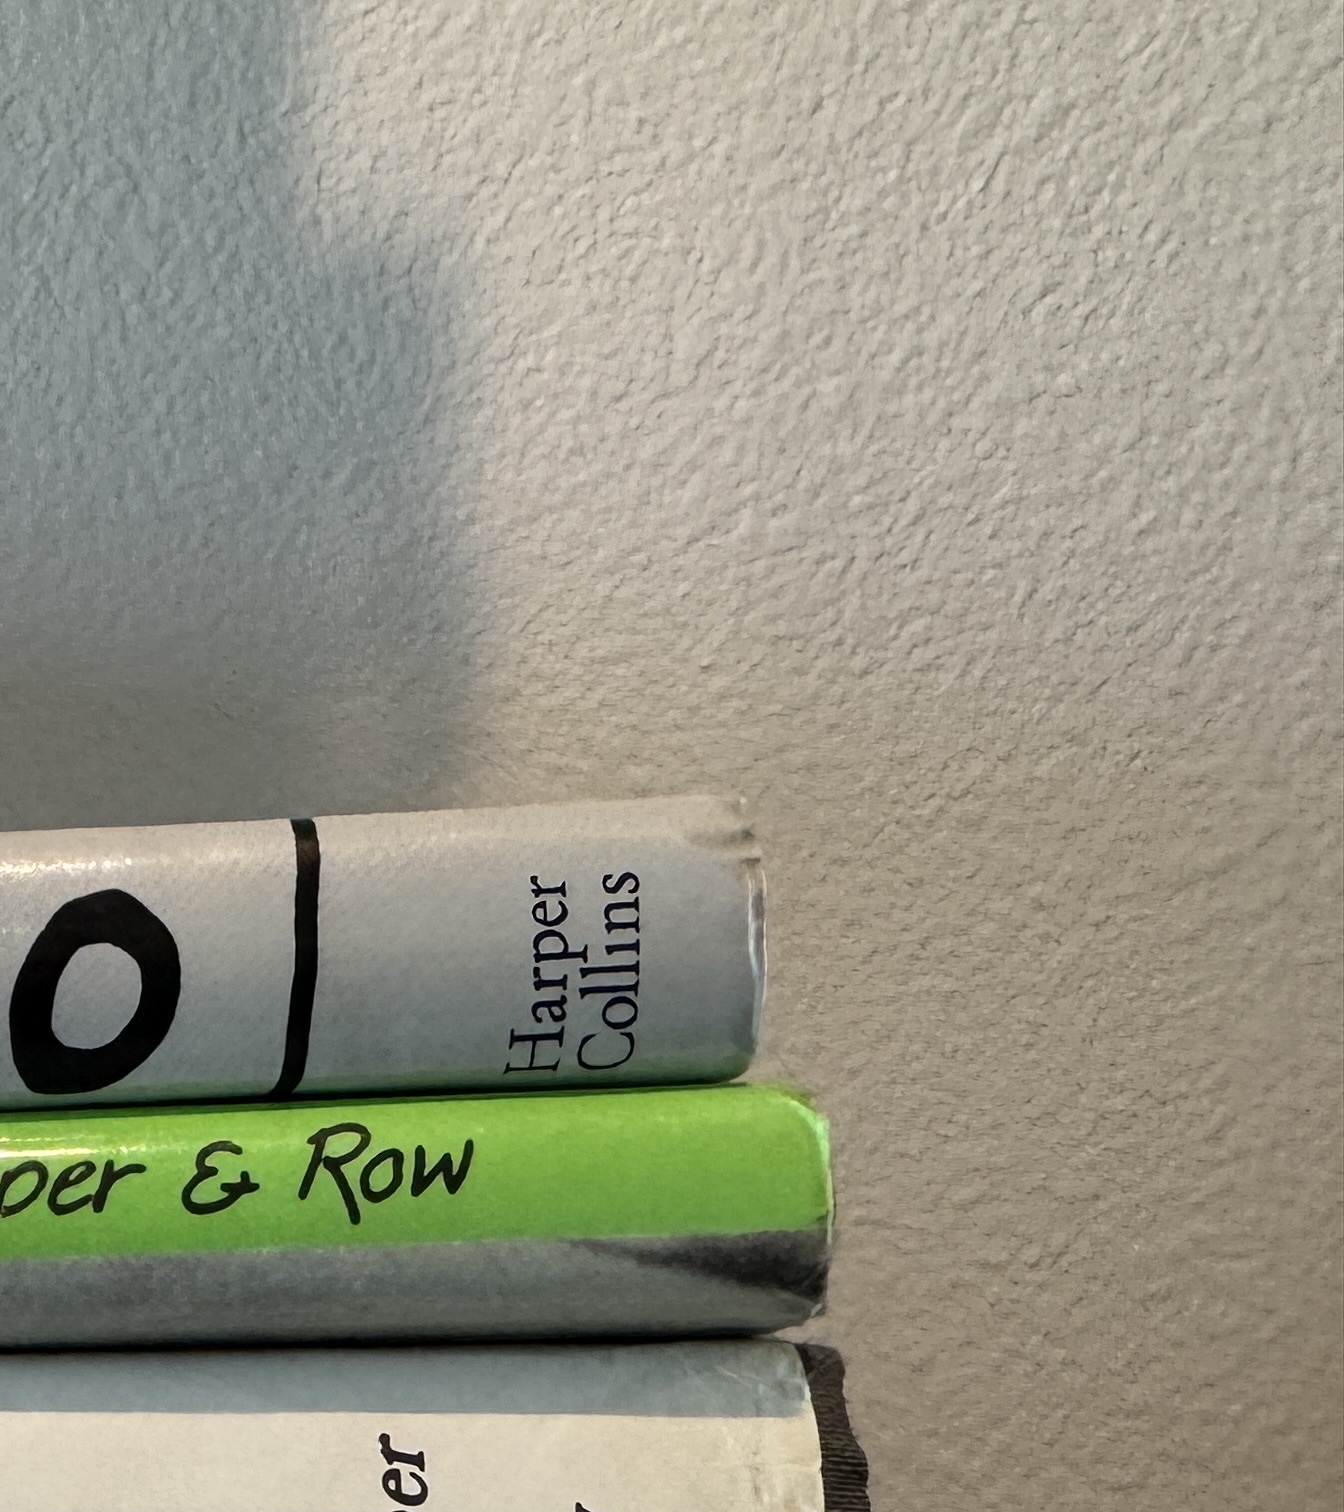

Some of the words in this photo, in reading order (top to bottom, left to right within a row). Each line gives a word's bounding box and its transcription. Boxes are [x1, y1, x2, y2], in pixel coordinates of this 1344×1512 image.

[8, 887, 183, 1096] O
[503, 874, 588, 1077] Harper
[576, 870, 641, 1072] Collins
[181, 1141, 260, 1215] &
[298, 1123, 473, 1225] Row
